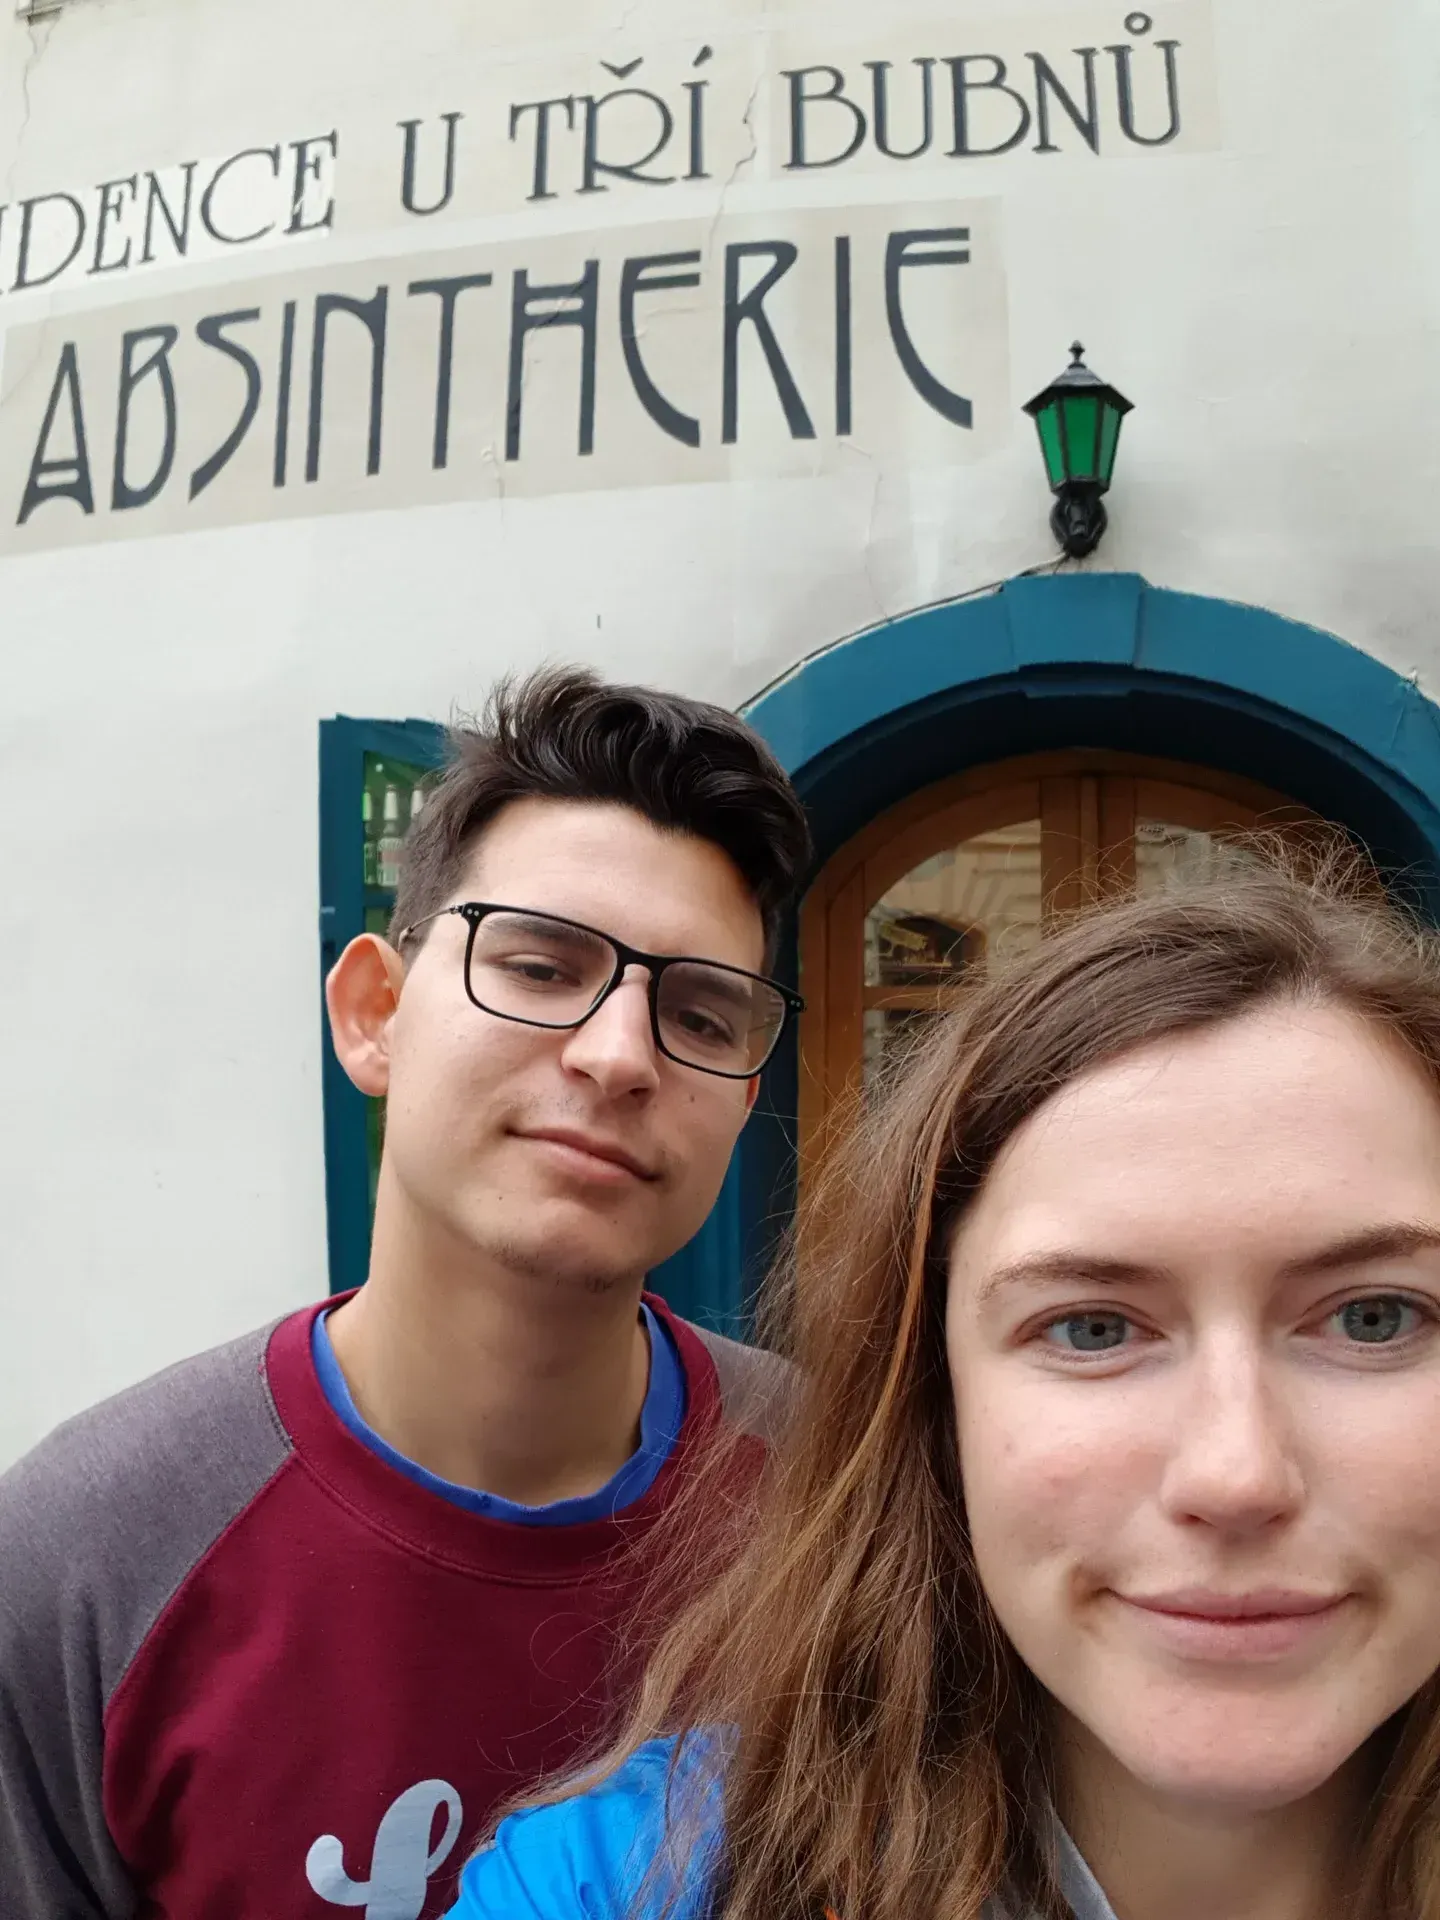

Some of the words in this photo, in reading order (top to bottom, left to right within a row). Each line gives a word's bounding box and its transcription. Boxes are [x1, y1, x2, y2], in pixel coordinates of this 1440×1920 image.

[397, 111, 465, 217] U
[508, 45, 713, 202] TŘÍ
[779, 11, 1183, 170] BUBNŮ
[15, 226, 974, 527] ABSINTHERIE
